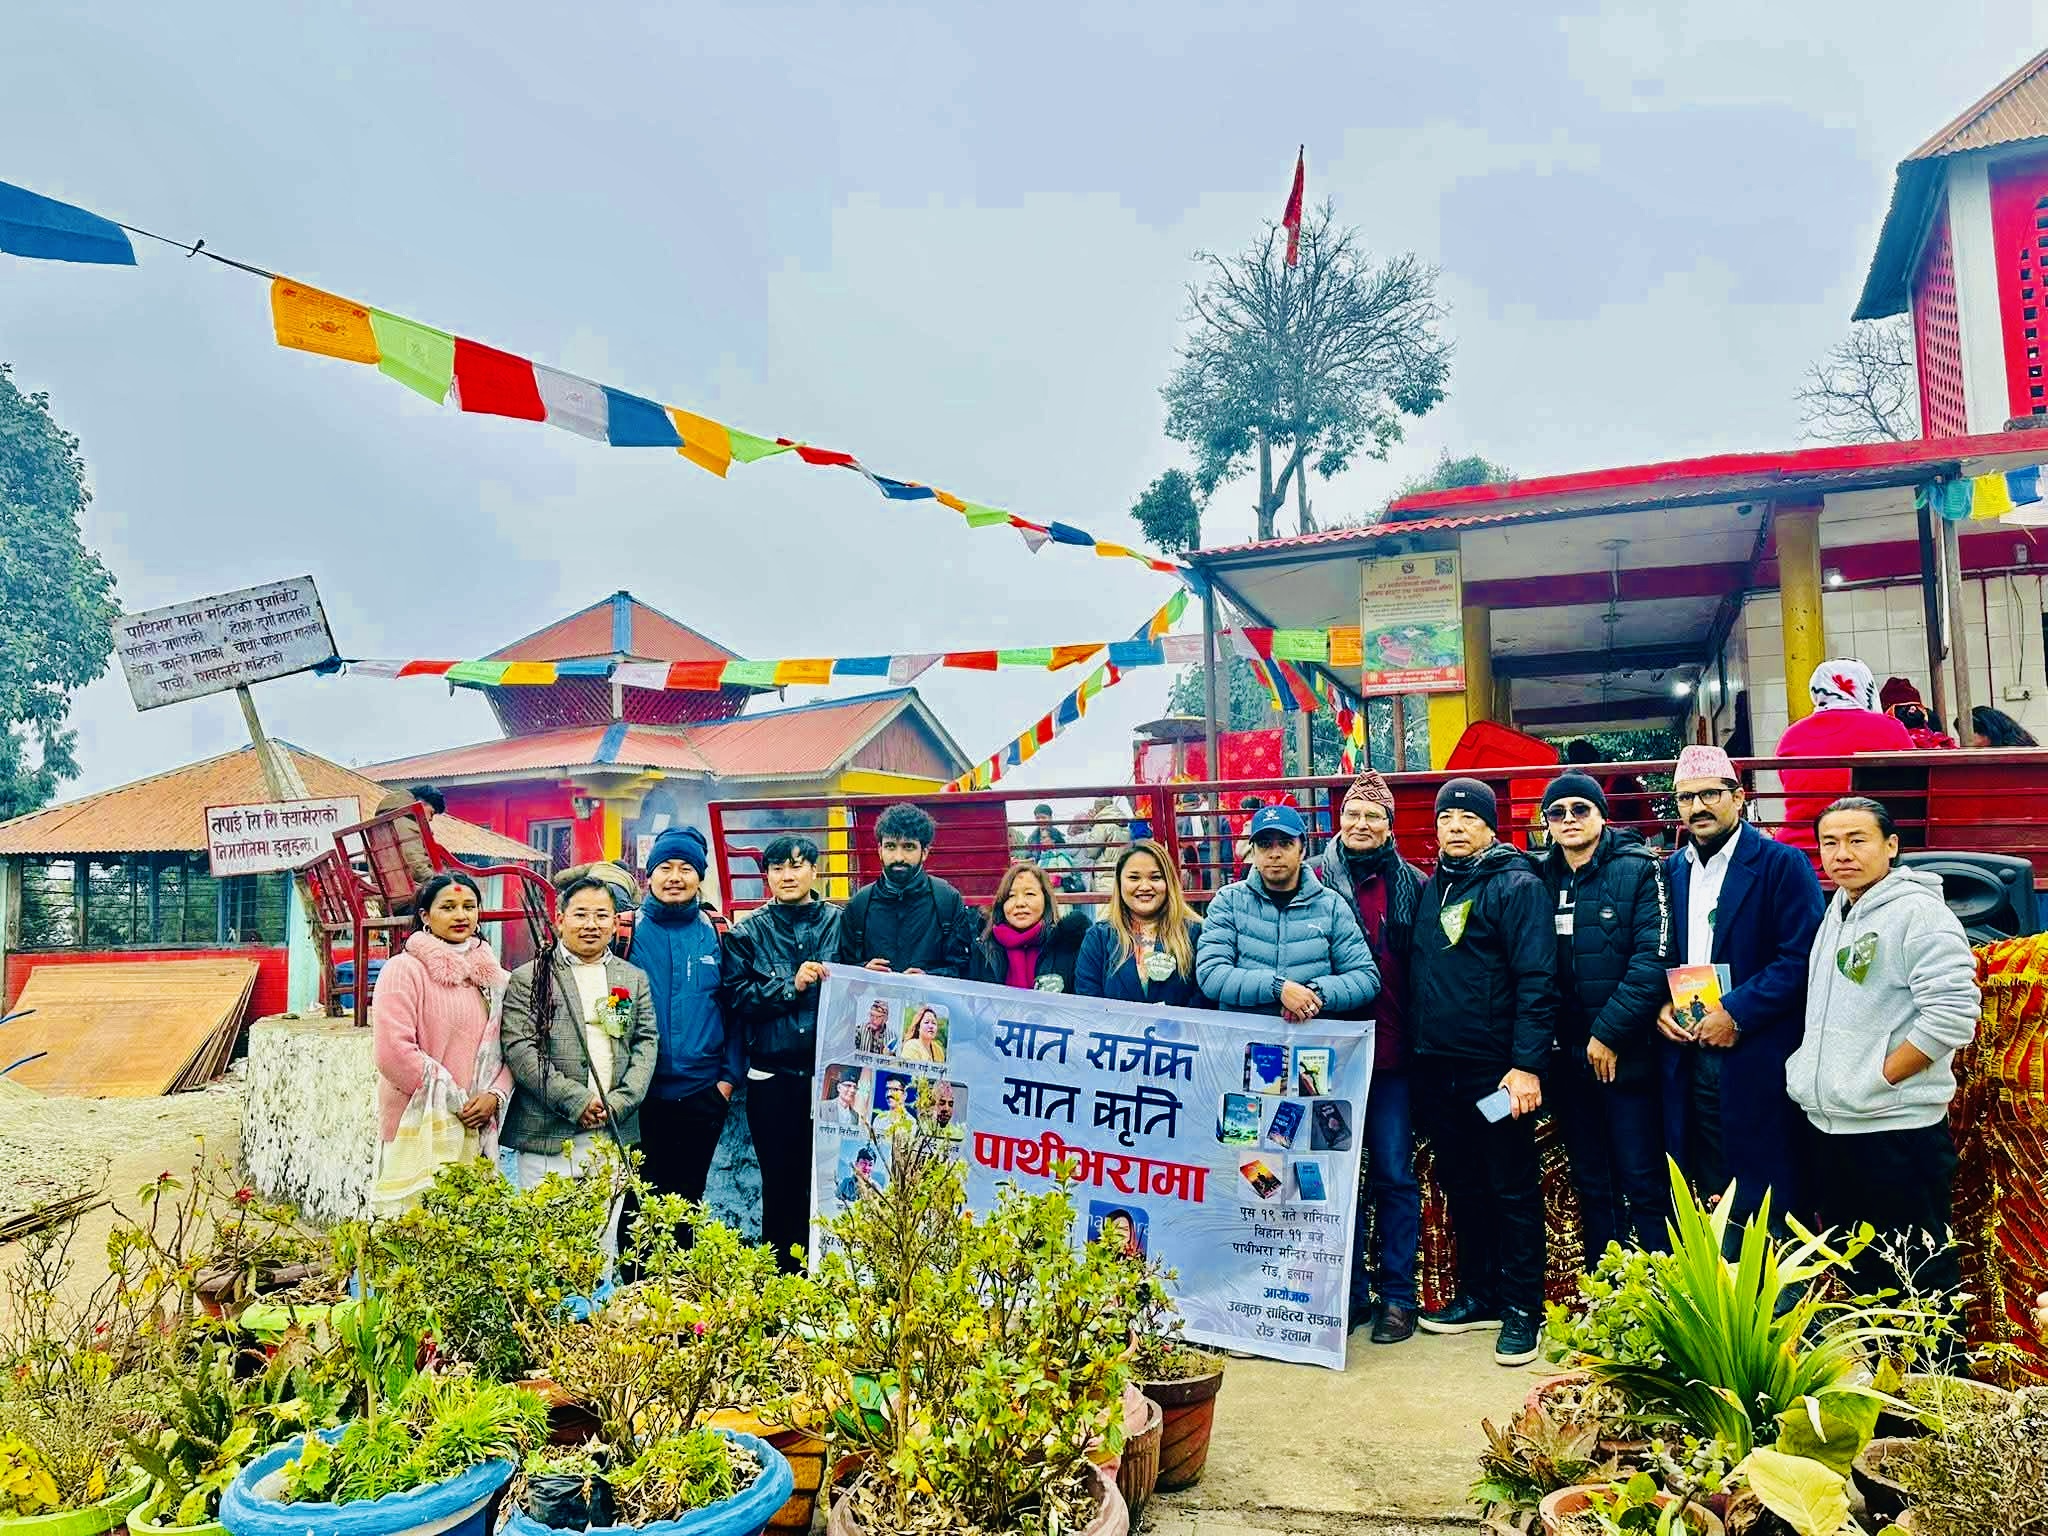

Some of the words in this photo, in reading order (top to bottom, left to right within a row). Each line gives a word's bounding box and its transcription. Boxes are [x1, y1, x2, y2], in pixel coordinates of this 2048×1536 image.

[174, 611, 203, 627] माता
[995, 1019, 1074, 1064] सात
[1086, 1025, 1200, 1081] सर्जक
[1003, 1077, 1081, 1123] सात
[1093, 1085, 1183, 1147] कृति
[973, 1131, 1210, 1204] पाथीभरामा
[1240, 1206, 1256, 1221] पुस
[1261, 1208, 1276, 1222] १९
[1281, 1207, 1297, 1221] गते
[1288, 1228, 1302, 1242] ११
[1232, 1241, 1273, 1257] पाथीभरा
[1278, 1244, 1307, 1260] मन्दिर
[1312, 1249, 1344, 1265] परिसर
[1287, 1268, 1314, 1282] इलाम
[1263, 1286, 1311, 1304] आयोजक
[1265, 1304, 1304, 1322] साहित्य
[1280, 1327, 1312, 1344] इलाम
